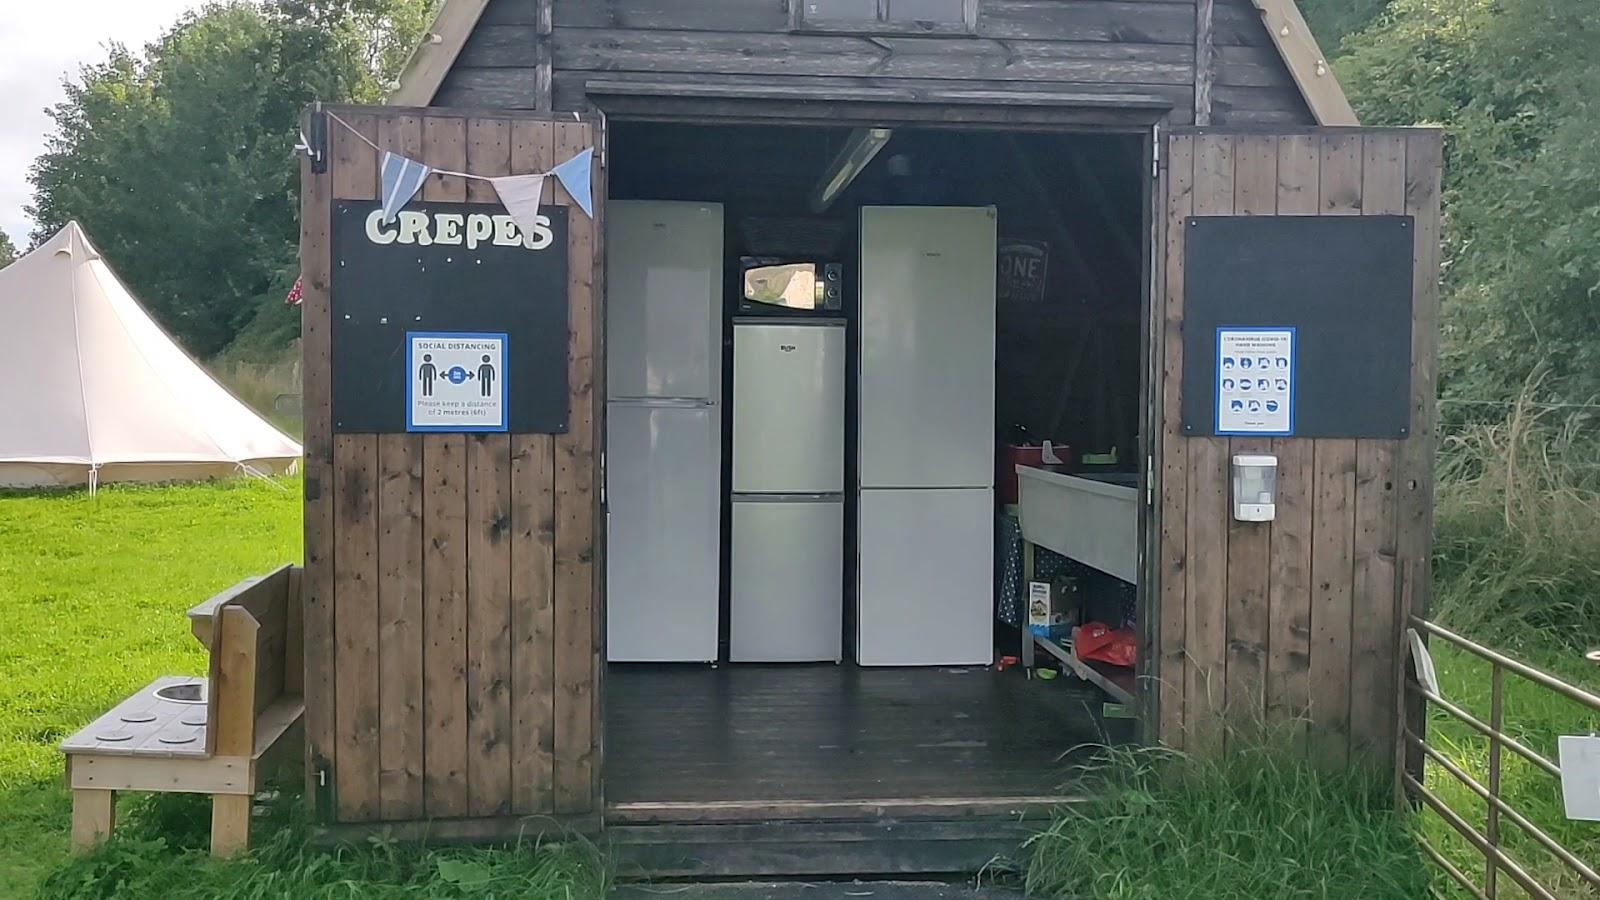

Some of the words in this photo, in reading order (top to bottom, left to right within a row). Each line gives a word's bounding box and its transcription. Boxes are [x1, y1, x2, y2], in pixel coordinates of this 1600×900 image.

[366, 209, 553, 250] CREPES
[418, 400, 441, 408] Please
[442, 400, 460, 409] keep
[467, 400, 497, 408] distance
